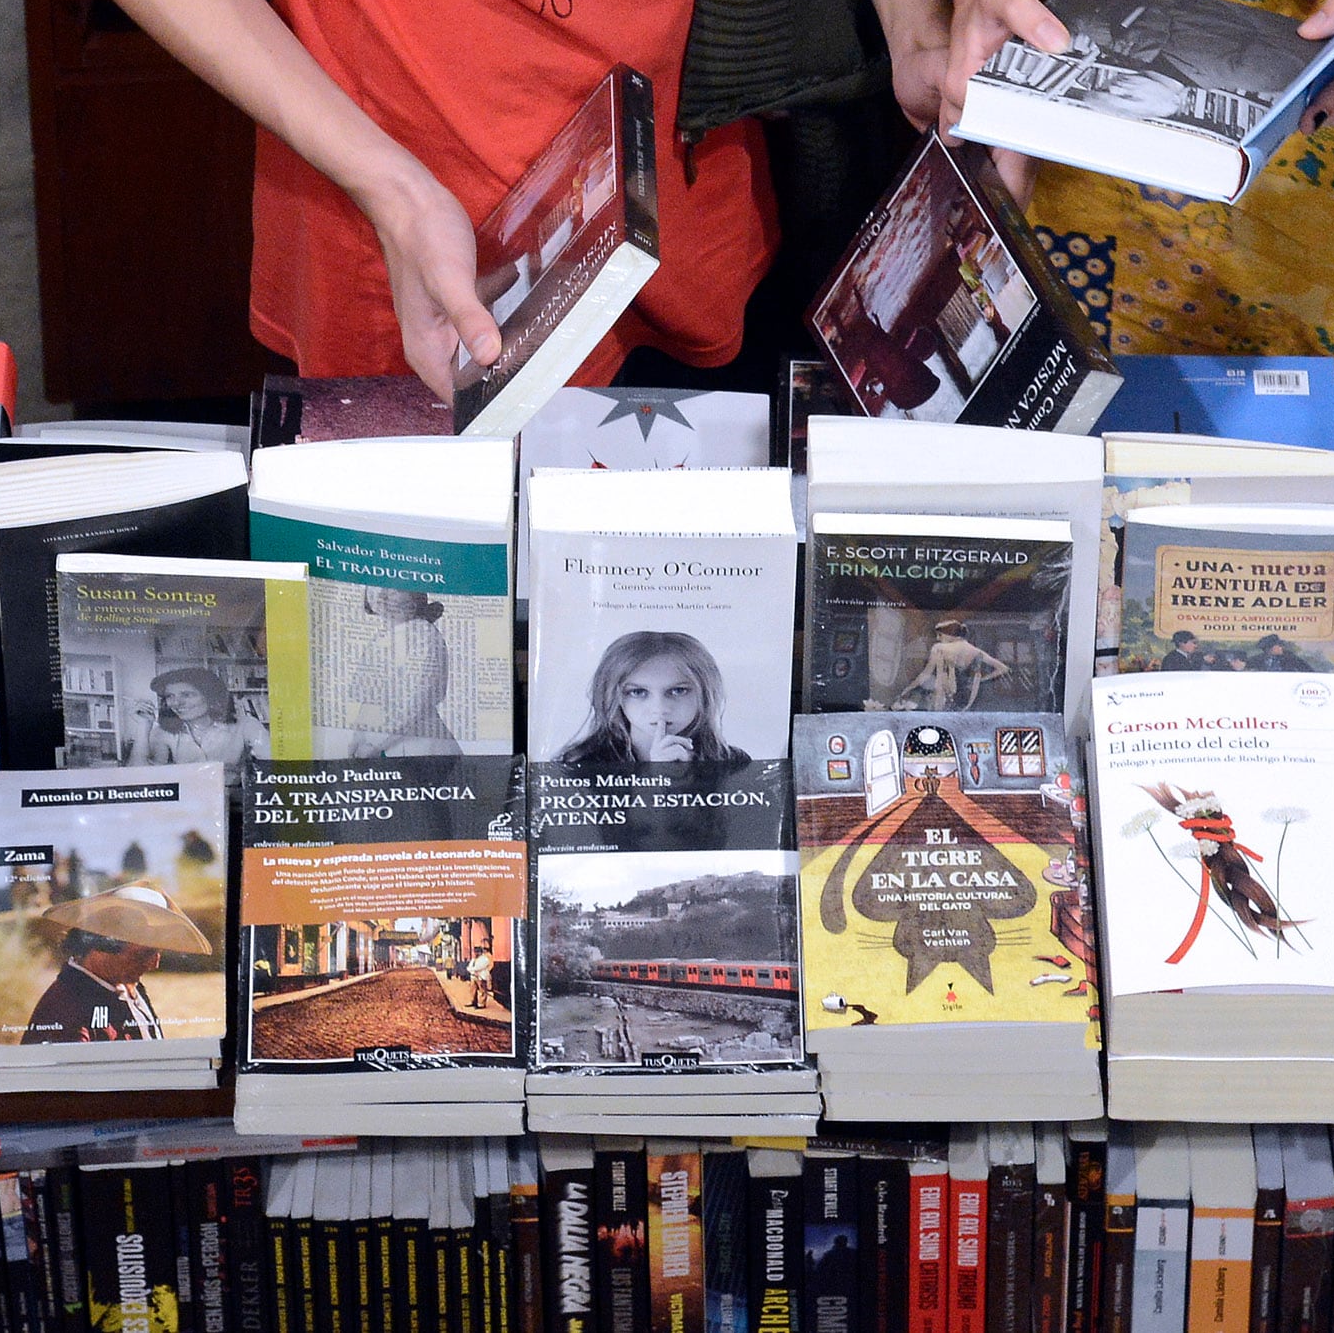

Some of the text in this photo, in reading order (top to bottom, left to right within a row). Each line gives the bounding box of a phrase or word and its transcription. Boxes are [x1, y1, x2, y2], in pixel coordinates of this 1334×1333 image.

[1020, 340, 1066, 411] MÚSICA
[1051, 355, 1073, 395] John
[317, 539, 441, 566] Salvador Benesdra
[845, 547, 1028, 564] SCOTT FITZGERALD
[339, 560, 446, 584] TRADUCTOR
[564, 557, 763, 580] Flannery O'Connor
[826, 562, 964, 580] TRIMALCIÓN
[1251, 565, 1326, 576] nueva
[1172, 577, 1288, 592] AVENTURA
[76, 585, 217, 607] Susan Sontag
[1171, 594, 1327, 608] IRENE ADLER
[1177, 614, 1229, 622] OSVALDO
[1107, 717, 1289, 734] Carson McCullers
[1131, 736, 1270, 753] aliento del cielo
[1109, 760, 1148, 769] Prólogo
[1159, 755, 1220, 765] comentarios
[1224, 755, 1236, 763] de
[1239, 756, 1280, 765] Rodrigo
[1283, 754, 1316, 763] Fresán
[255, 769, 402, 784] Leonardo Padura
[540, 773, 671, 788] Petros Márkaris
[28, 787, 174, 804] Antonio Benedetto
[254, 786, 476, 806] LA TRANSPARENCIA
[540, 790, 771, 810] PRÓXIMA ESTACIÓN,
[255, 806, 393, 824] DEL TIEMPO
[539, 811, 626, 826] ATENAS
[924, 828, 957, 844] EL
[4, 849, 46, 862] Zama
[278, 849, 523, 866] nueva esperada novela Leonardo Padura
[902, 850, 982, 867] TIGRE
[871, 871, 1018, 889] EN LA CASA
[904, 892, 1012, 901] HISTORIA CULTURAL
[924, 938, 971, 947] Vechten
[612, 1186, 627, 1212] NEVILLE
[824, 1168, 838, 1218] STUART NEVILLE
[661, 1170, 690, 1278] STEPHEN LEATHER
[919, 1187, 940, 1260] ERIK AXL SUND
[958, 1193, 979, 1267] ERIK AXL SUND
[766, 1209, 784, 1282] MACDONALD
[560, 1200, 591, 1314] DALIA NEGRA
[116, 1234, 151, 1315] EXQUISITOS
[919, 1262, 939, 1311] CATARSIS
[958, 1269, 978, 1310] TRAUMA
